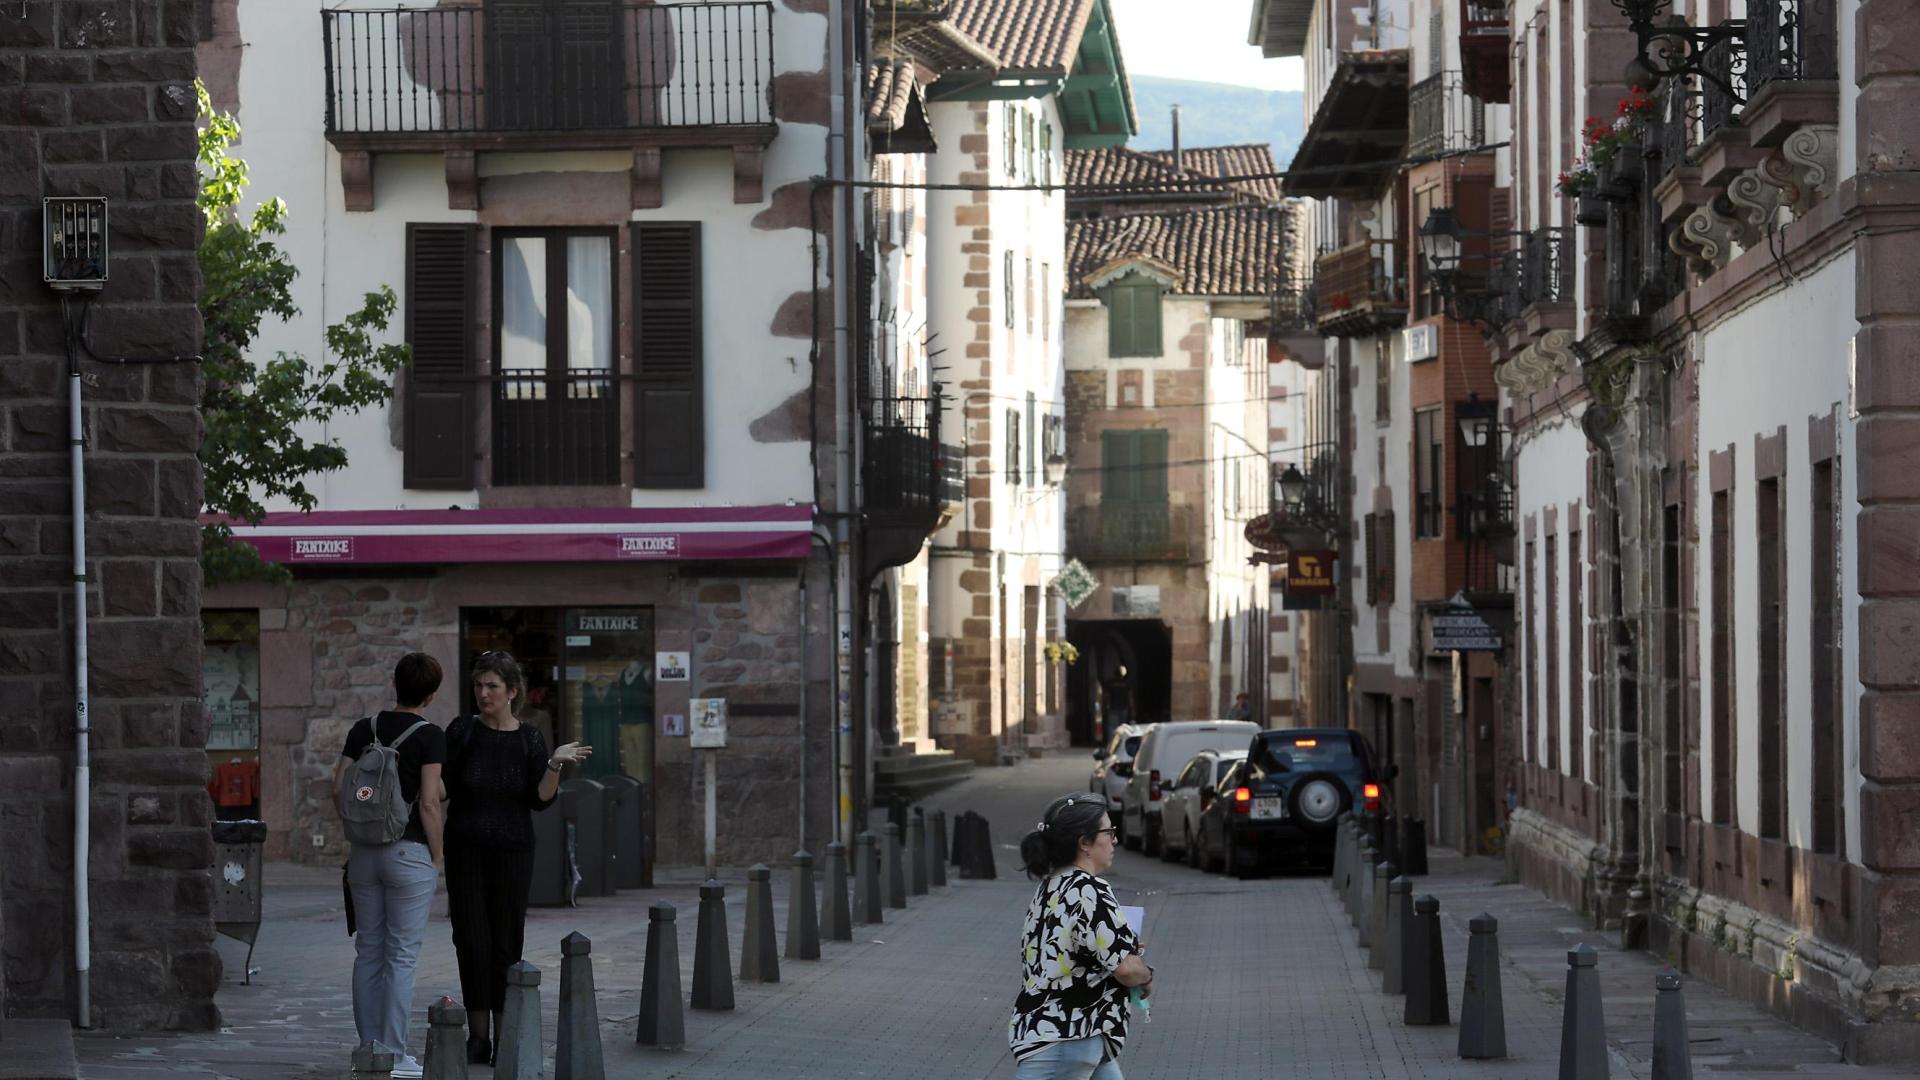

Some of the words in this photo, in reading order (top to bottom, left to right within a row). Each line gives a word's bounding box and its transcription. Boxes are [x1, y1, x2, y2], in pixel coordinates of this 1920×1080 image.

[295, 540, 349, 553] FANTXIKE
[622, 537, 675, 550] FANTXIKE
[579, 615, 639, 630] FANTXIKE
